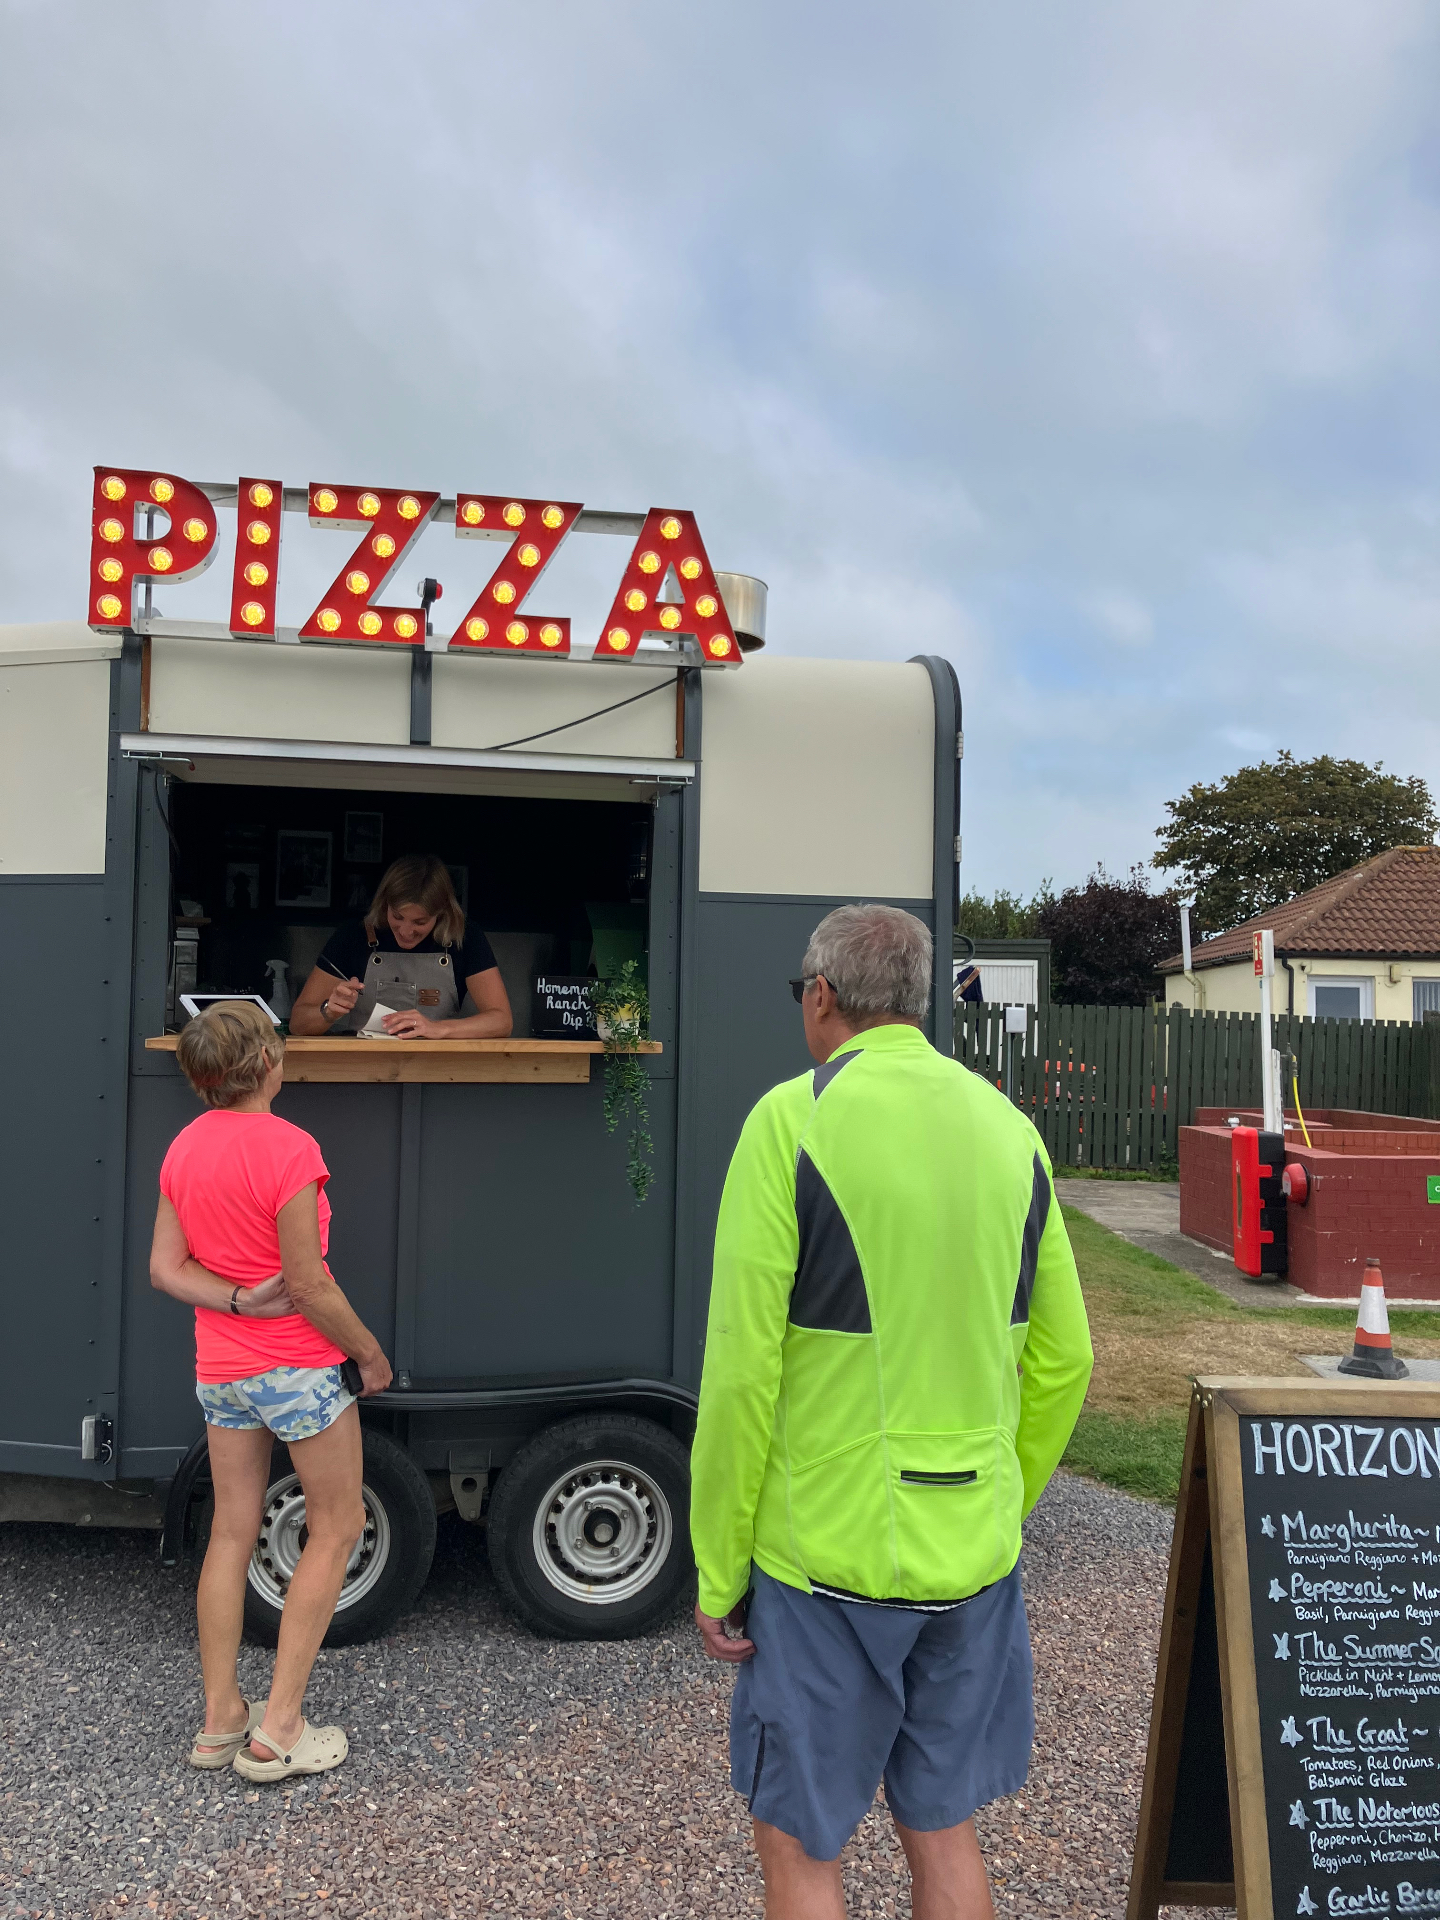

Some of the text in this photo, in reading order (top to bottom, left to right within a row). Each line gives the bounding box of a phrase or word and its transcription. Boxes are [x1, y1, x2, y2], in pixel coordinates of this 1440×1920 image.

[88, 466, 744, 670] PIZZA
[537, 977, 599, 995] Homema
[546, 996, 591, 1011] Ranch
[562, 1011, 583, 1031] Dip
[1251, 1422, 1440, 1479] HORIZON
[1287, 1549, 1351, 1571] Parmigiano
[1354, 1550, 1407, 1571] Reggiano
[1291, 1572, 1388, 1603] Pepperoni
[1295, 1605, 1329, 1624] Basil,
[1333, 1605, 1400, 1631] Parmigiano
[1293, 1630, 1343, 1660] The
[1343, 1634, 1419, 1660] Summer
[1298, 1666, 1344, 1682] Pickled
[1345, 1668, 1359, 1681] in
[1375, 1682, 1440, 1704] Parmigiano
[1306, 1715, 1352, 1746] The
[1356, 1717, 1409, 1745] Goat
[1299, 1756, 1362, 1773] Tomatoes,
[1367, 1755, 1391, 1771] Red
[1308, 1771, 1408, 1791] Balsamic Glaze
[1312, 1797, 1440, 1822] The Notorious
[1309, 1829, 1377, 1853] Pepperoni,
[1378, 1828, 1432, 1846] Chorizo,
[1312, 1846, 1440, 1875] Reggiano, Mozzarella
[1327, 1884, 1390, 1911] Garlic
